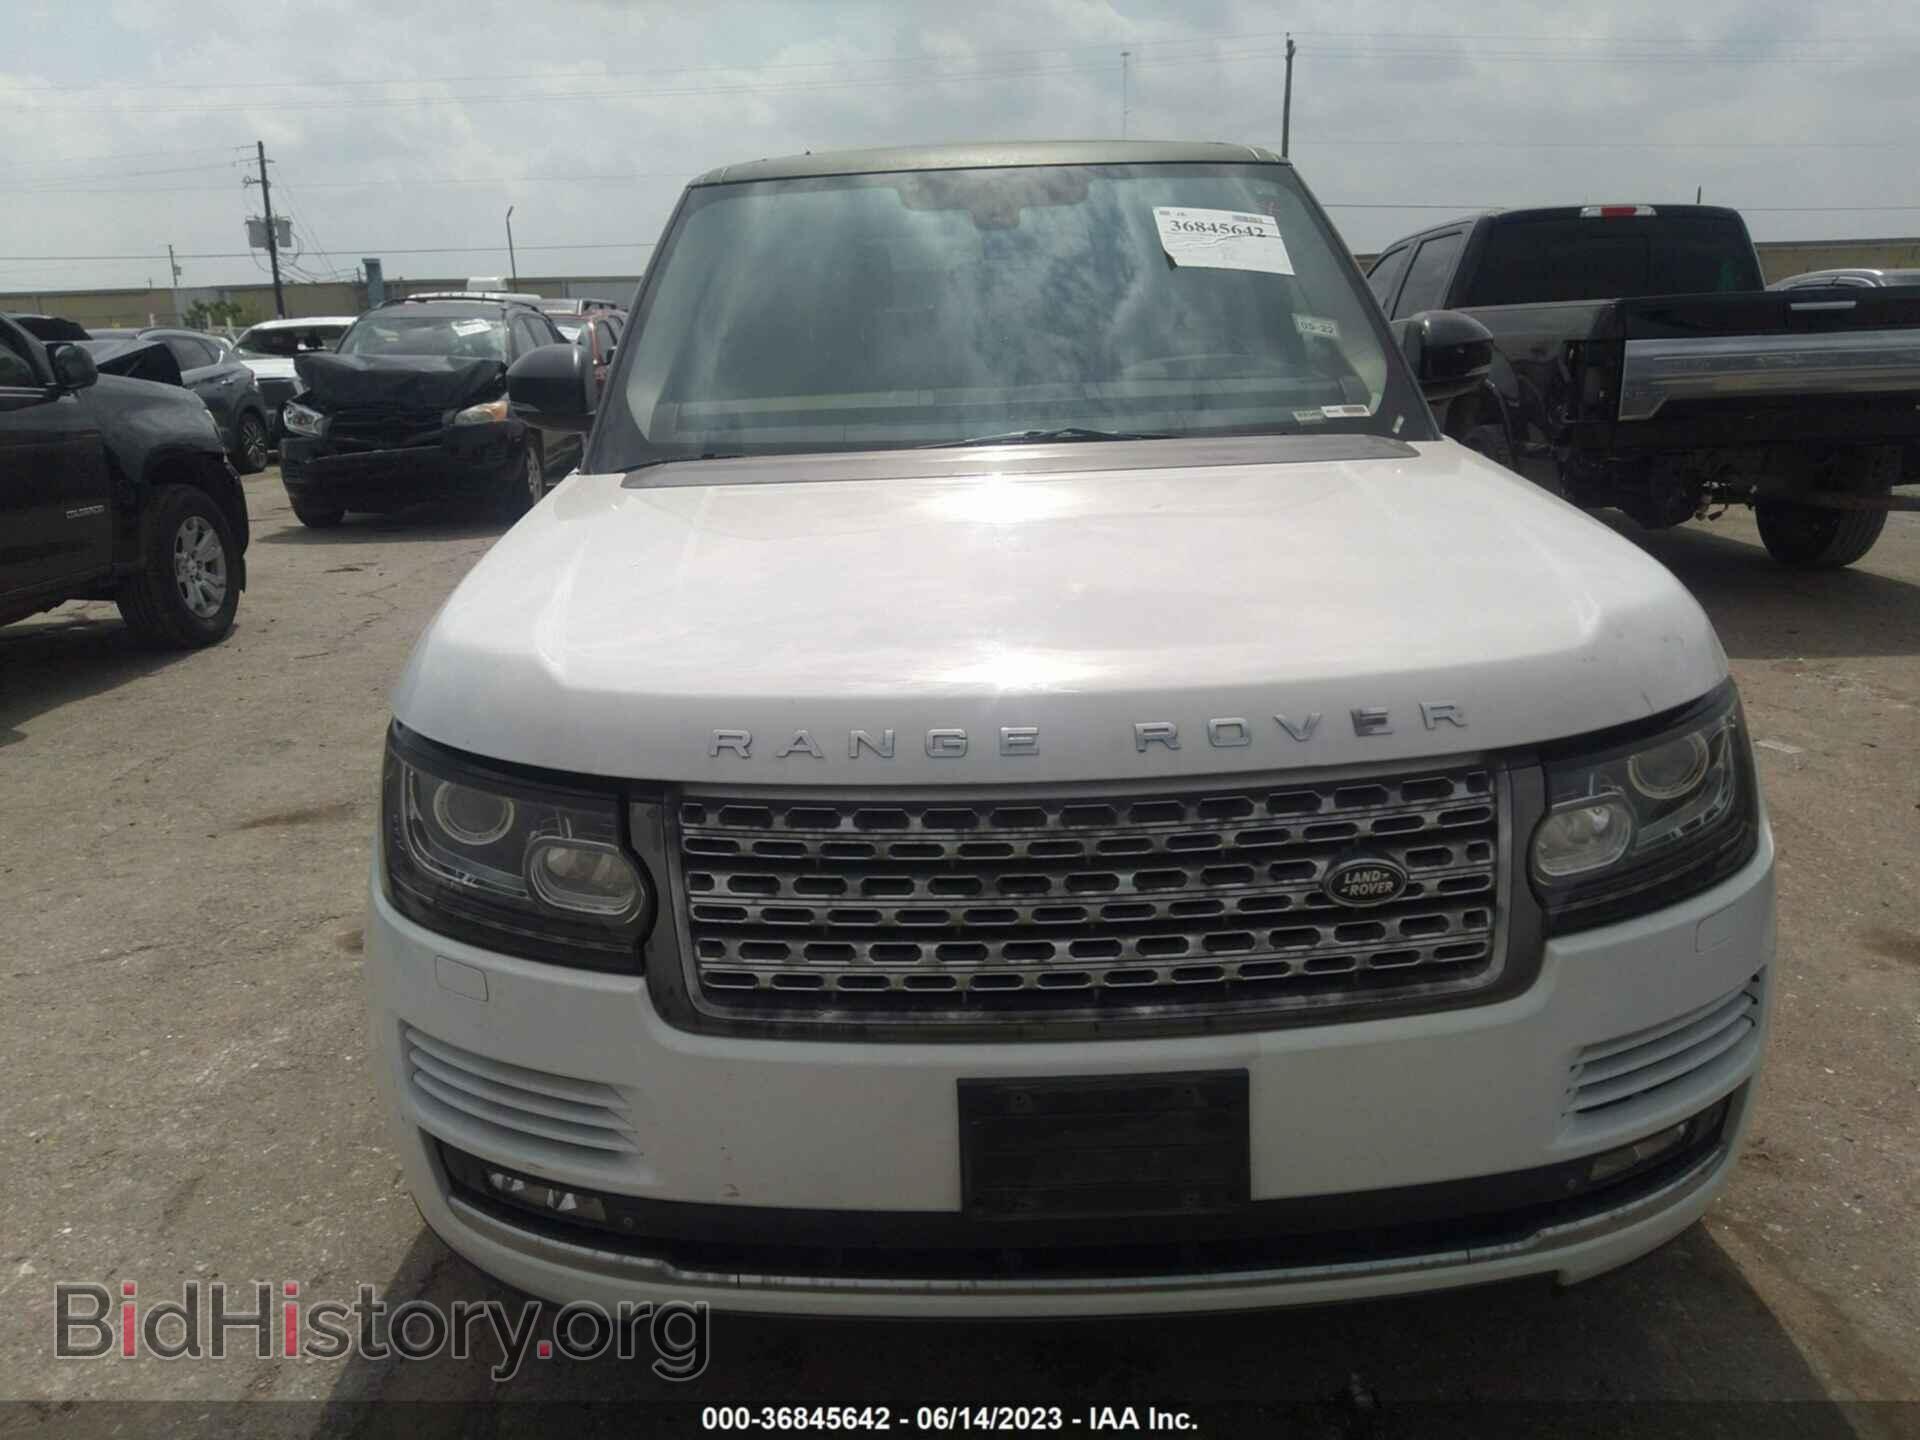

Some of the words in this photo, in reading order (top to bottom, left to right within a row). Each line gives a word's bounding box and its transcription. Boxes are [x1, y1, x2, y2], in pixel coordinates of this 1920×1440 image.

[1169, 220, 1267, 238] 36845642
[709, 727, 1040, 759] RANGE
[1134, 702, 1467, 752] ROVER
[1344, 870, 1382, 884] LAND
[1347, 881, 1394, 897] ROVER
